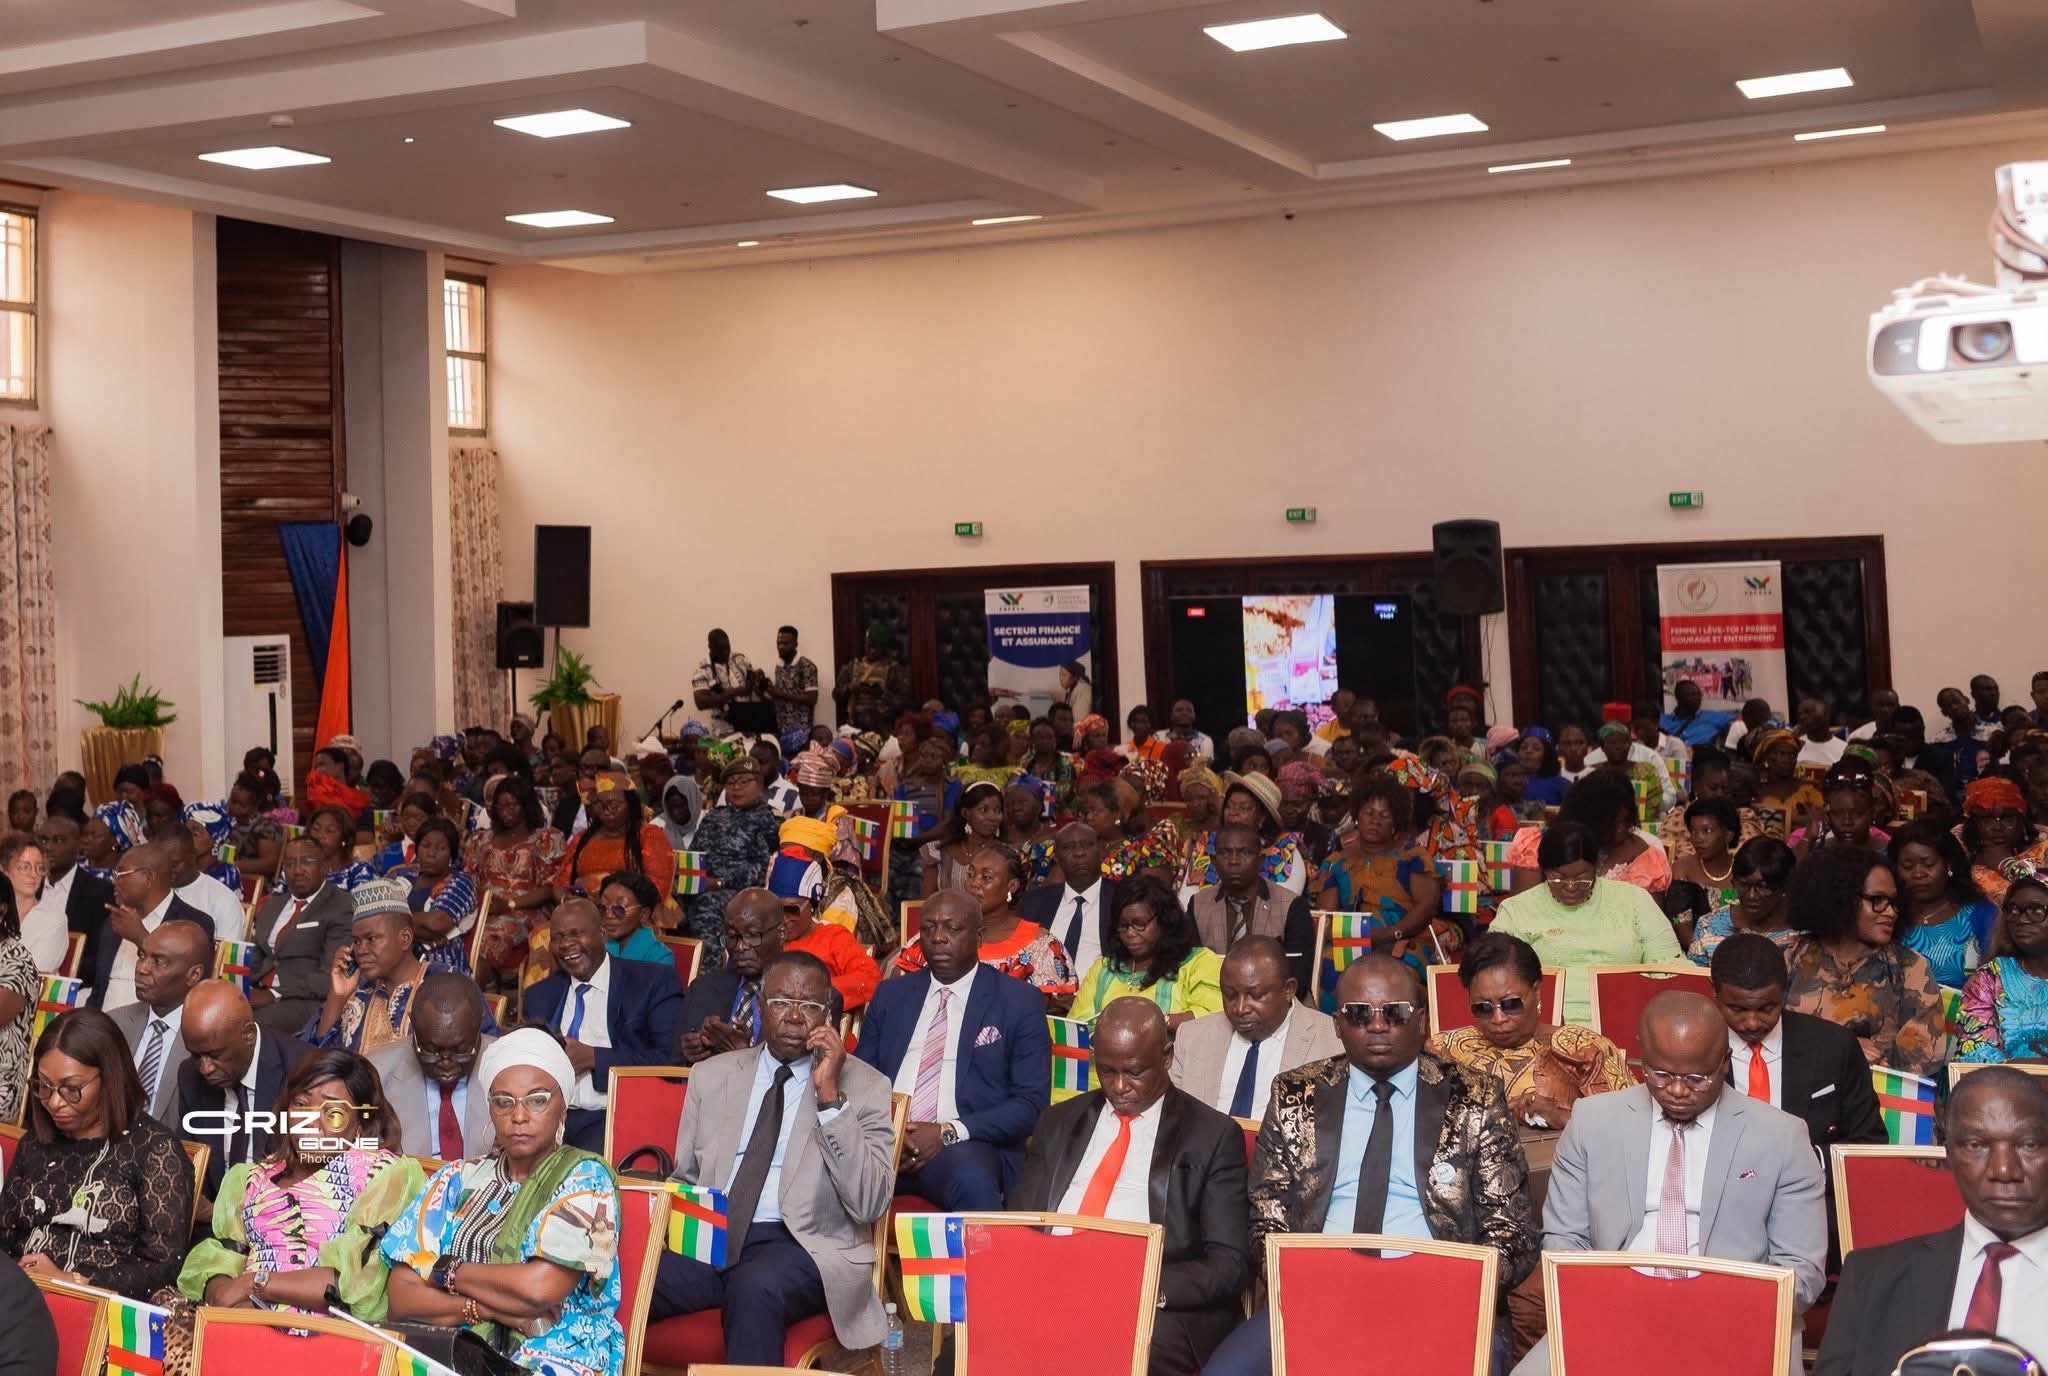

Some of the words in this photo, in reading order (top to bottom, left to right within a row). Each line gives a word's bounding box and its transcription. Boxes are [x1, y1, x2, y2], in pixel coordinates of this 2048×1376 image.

[994, 627, 1036, 636] SECTEUR
[1038, 625, 1080, 635] FINANCE
[1001, 638, 1013, 646] ET
[1015, 636, 1073, 646] ASSURANCE
[1671, 635, 1711, 644] COURAGE
